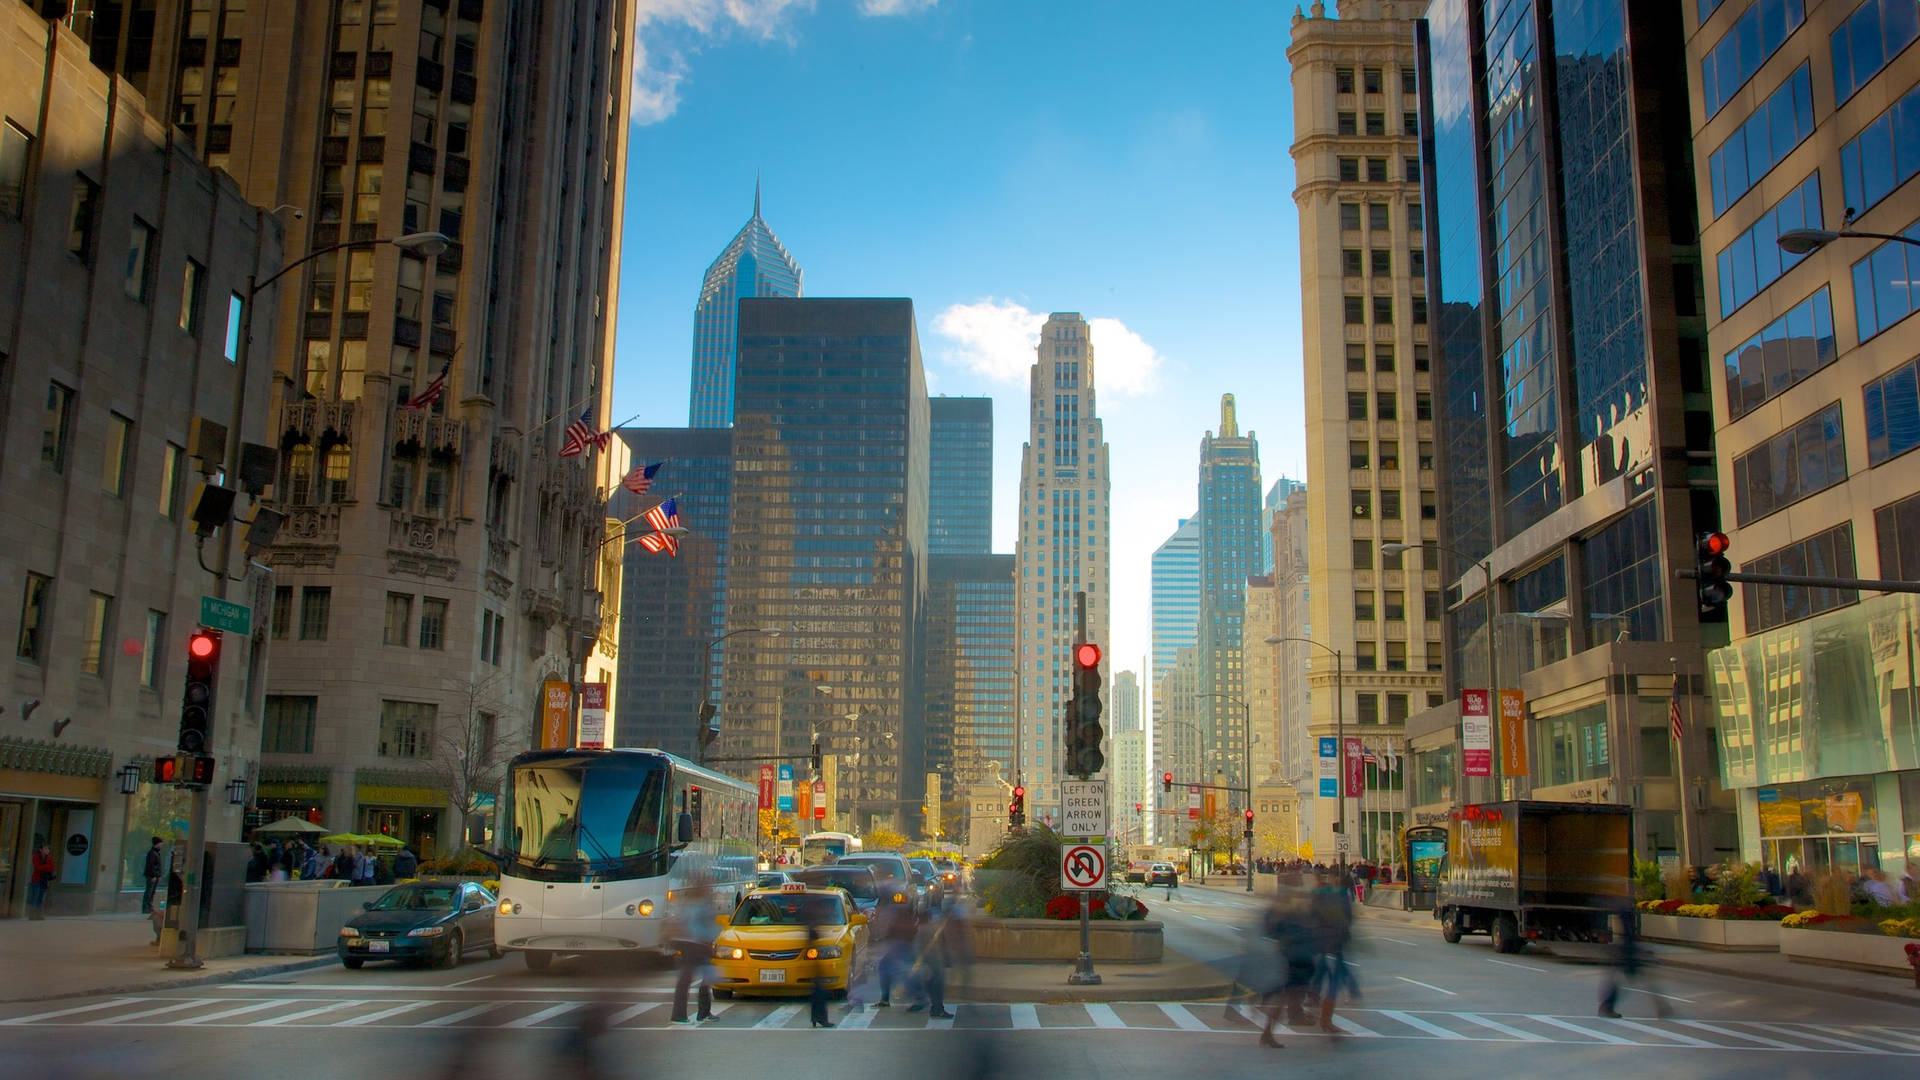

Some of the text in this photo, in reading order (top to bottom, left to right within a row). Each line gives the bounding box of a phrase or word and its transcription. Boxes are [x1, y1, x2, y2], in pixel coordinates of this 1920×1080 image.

[211, 602, 240, 618] MICHIGAN
[548, 691, 567, 699] GLAD
[586, 689, 601, 697] GLAD
[1508, 721, 1519, 769] CHICAGO
[1063, 784, 1104, 795] LEFT ON
[1067, 797, 1101, 807] GREEN
[1066, 810, 1102, 819] ARROW
[1071, 822, 1098, 832] ONLY
[1471, 827, 1502, 837] FLOORING
[1337, 842, 1349, 851] 30
[1471, 837, 1502, 847] RESOURCES
[783, 883, 805, 891] TAXI
